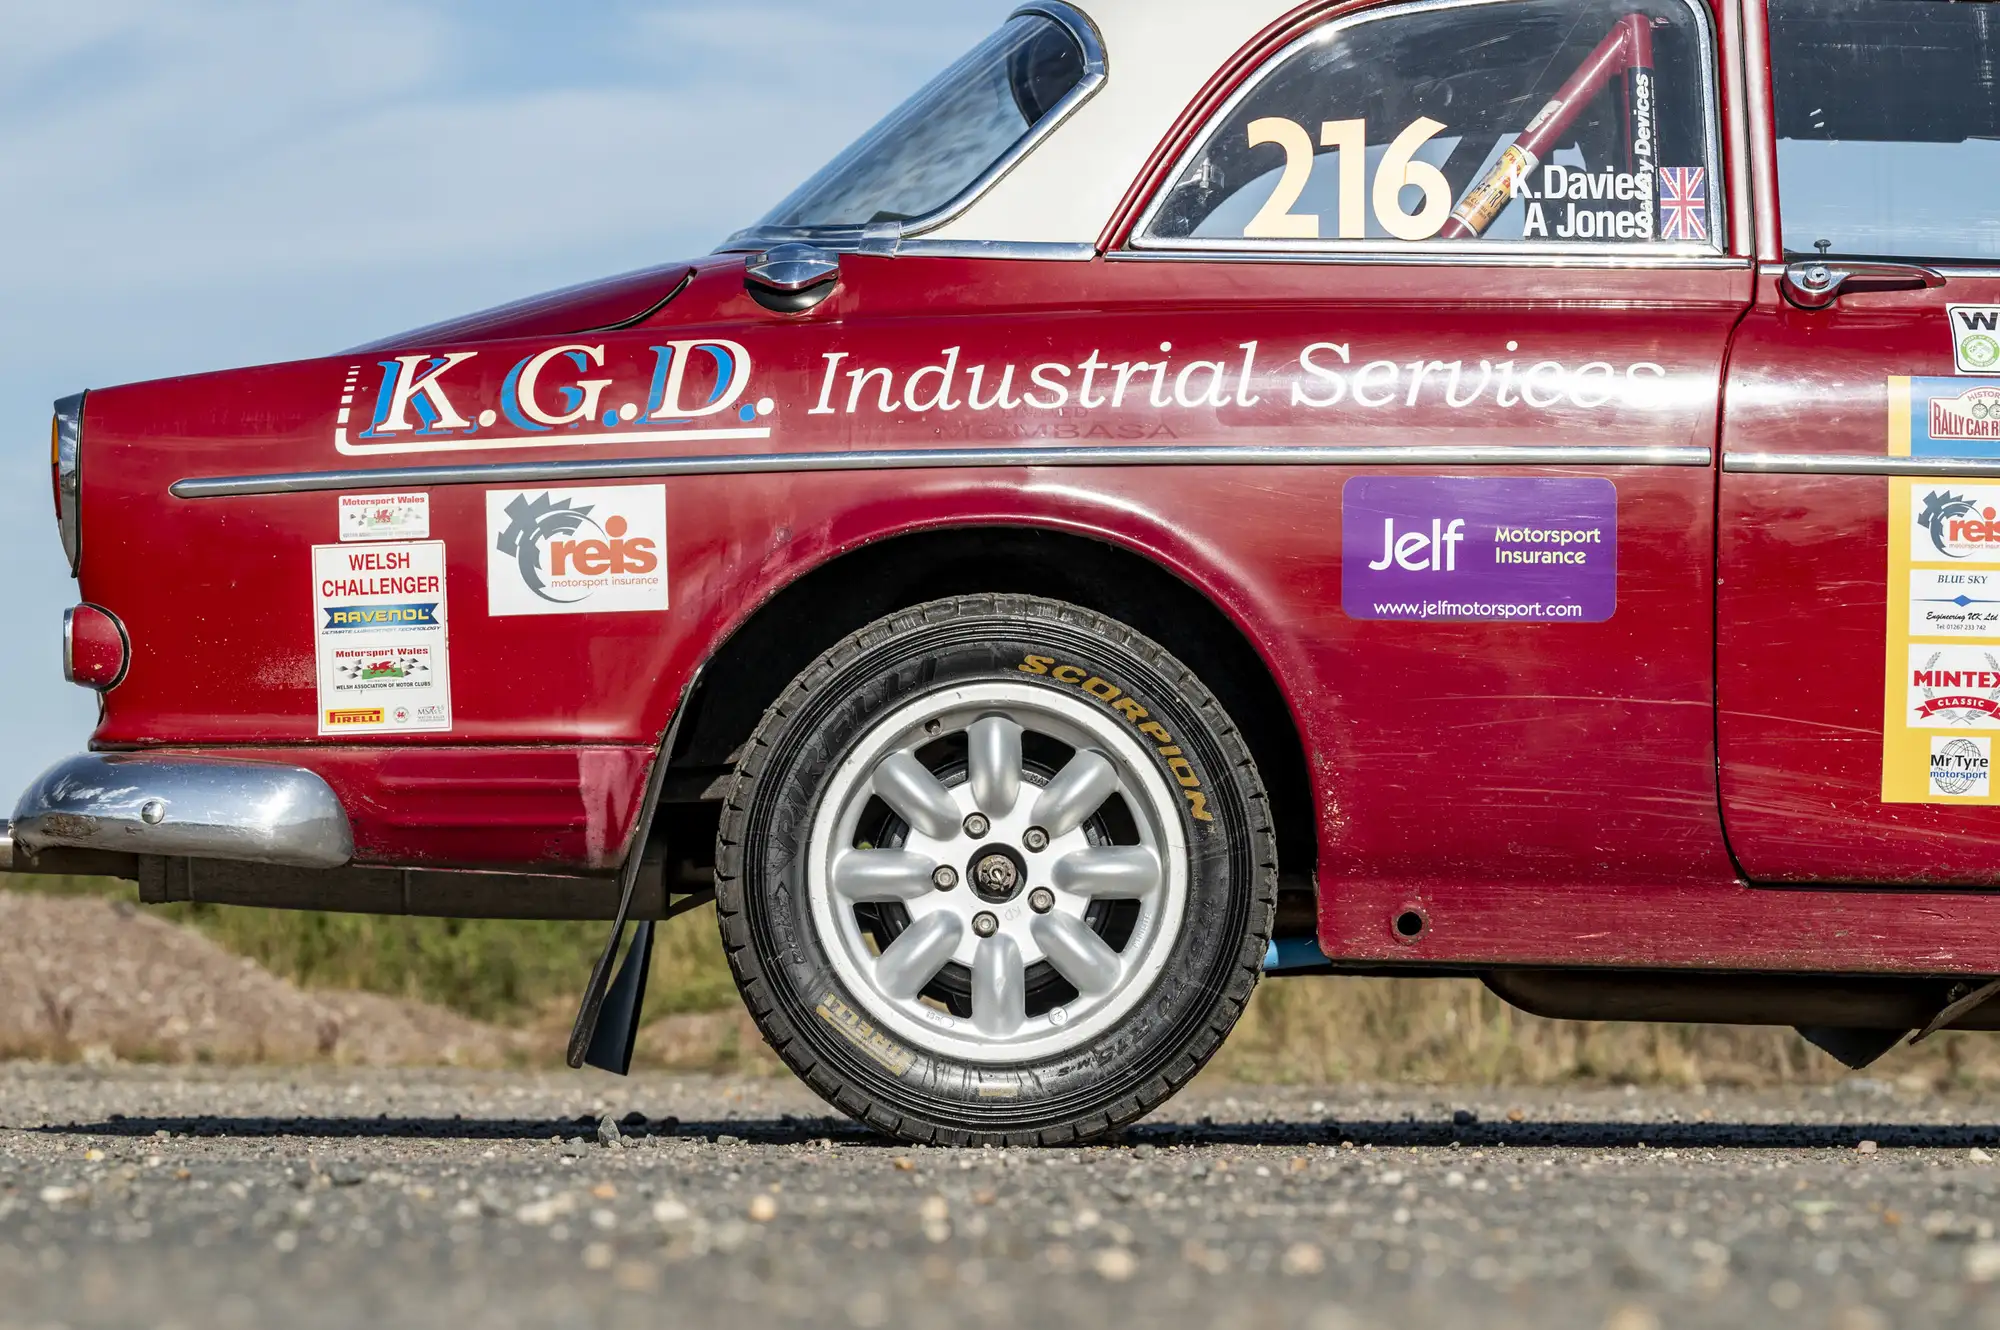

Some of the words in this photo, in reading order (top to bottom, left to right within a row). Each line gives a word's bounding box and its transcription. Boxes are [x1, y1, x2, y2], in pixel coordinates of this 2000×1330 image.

[1634, 73, 1652, 155] Devices
[1243, 116, 1452, 240] 216
[1510, 165, 1653, 199] K.Davies
[1523, 203, 1548, 237] A
[1556, 203, 1653, 238] Jones
[808, 340, 1259, 414] Industrial
[1292, 340, 1666, 409] Services
[359, 339, 775, 438] K.G.D.
[1933, 401, 1965, 436] RALLY
[1966, 418, 1989, 436] CAR
[1991, 420, 2000, 437] R
[342, 497, 395, 506] Motorsport
[397, 495, 425, 504] Wales
[550, 515, 658, 576] reis
[1368, 518, 1465, 571] Jelf
[1494, 527, 1601, 546] Motorsport
[1949, 542, 1984, 550] motorsport
[348, 552, 410, 571] WELSH
[1495, 547, 1586, 564] Insurance
[322, 576, 440, 597] CHALLENGER
[551, 577, 609, 589] motorsport
[611, 576, 659, 586] insurance
[1937, 574, 1965, 584] BLUE
[1967, 574, 1988, 585] SKY
[1373, 600, 1582, 618] www.jelfmotorsport.com
[1925, 611, 1966, 622] Engineering
[1967, 612, 1982, 621] UK
[1983, 611, 1999, 621] Ltd
[1946, 623, 1963, 631] 01267
[335, 648, 394, 658] Motorsport
[397, 647, 429, 656] Wales
[1937, 697, 1985, 708] CLASSIC
[329, 710, 381, 724] PIRELLI
[1019, 655, 1213, 822] SCORPION
[1930, 754, 1952, 767] Mr
[1954, 754, 1989, 770] Tyre
[1930, 770, 1987, 781] motorsport
